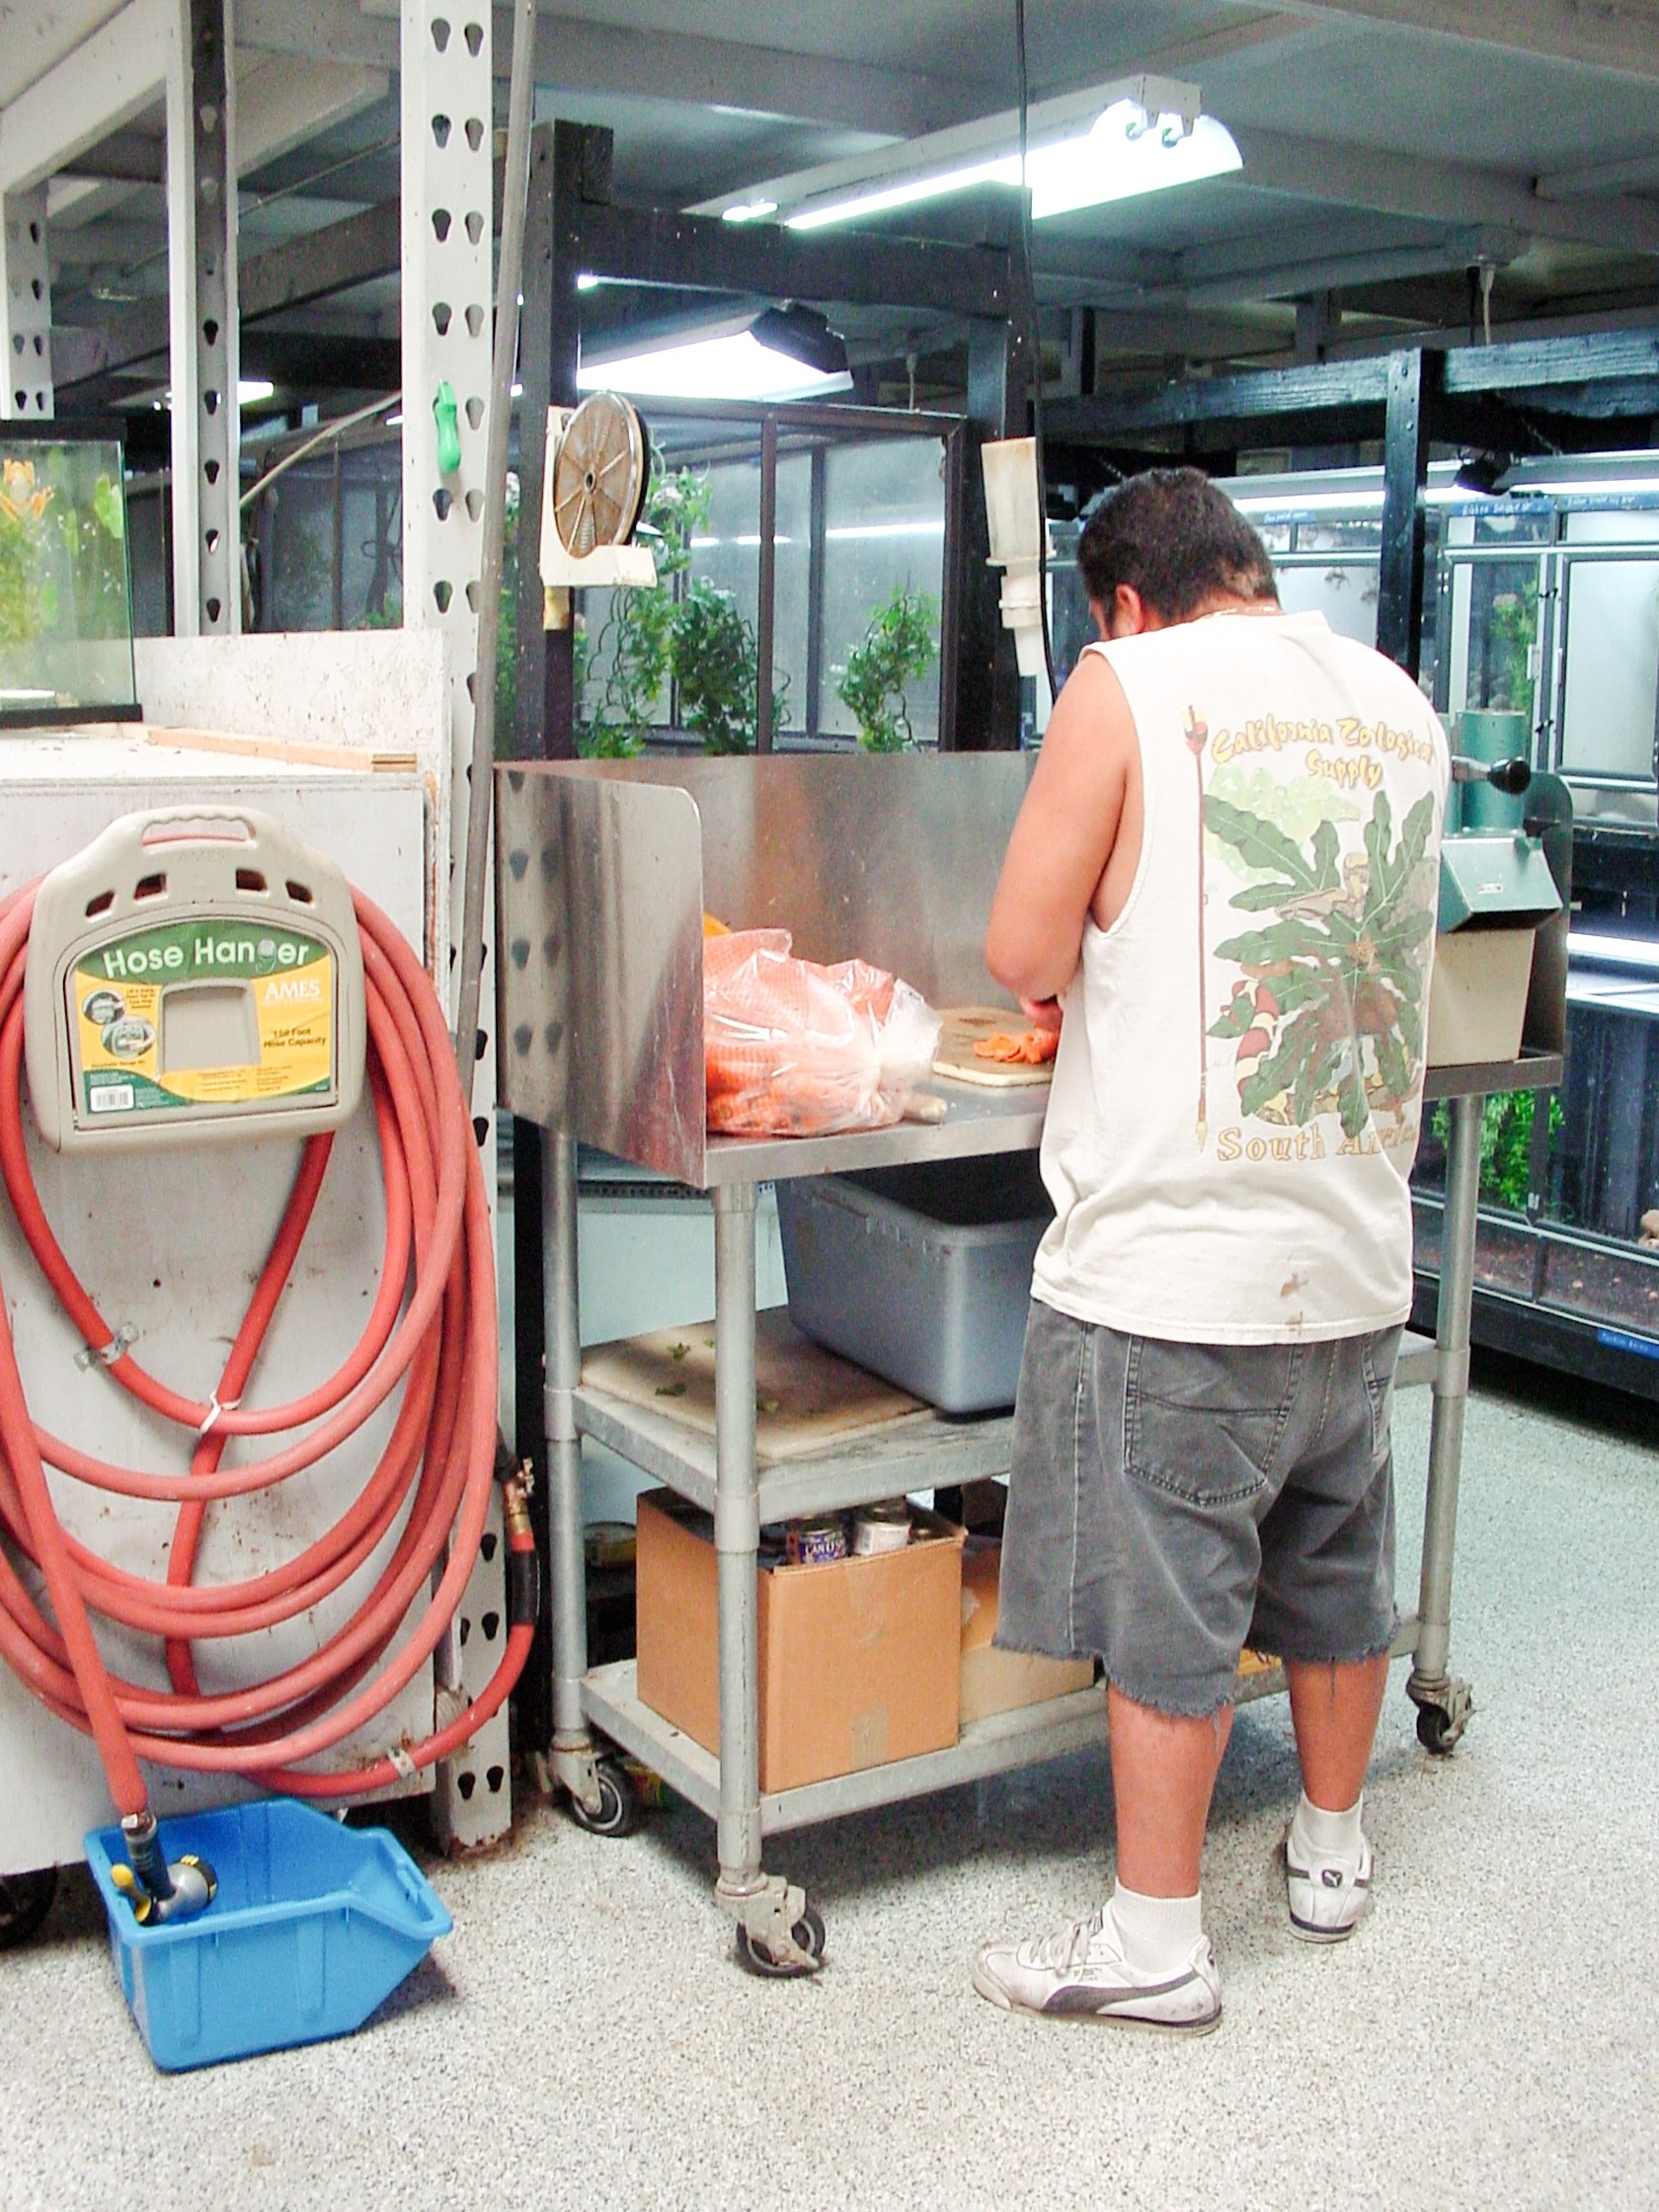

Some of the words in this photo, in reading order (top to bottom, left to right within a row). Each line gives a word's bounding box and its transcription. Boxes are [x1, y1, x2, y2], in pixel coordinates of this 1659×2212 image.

[1212, 712, 1334, 764] California
[1304, 748, 1382, 790] Supply
[102, 944, 184, 979] Hose
[195, 934, 310, 974] Hanger
[265, 979, 321, 1000] AMES
[1218, 1122, 1326, 1162] South
